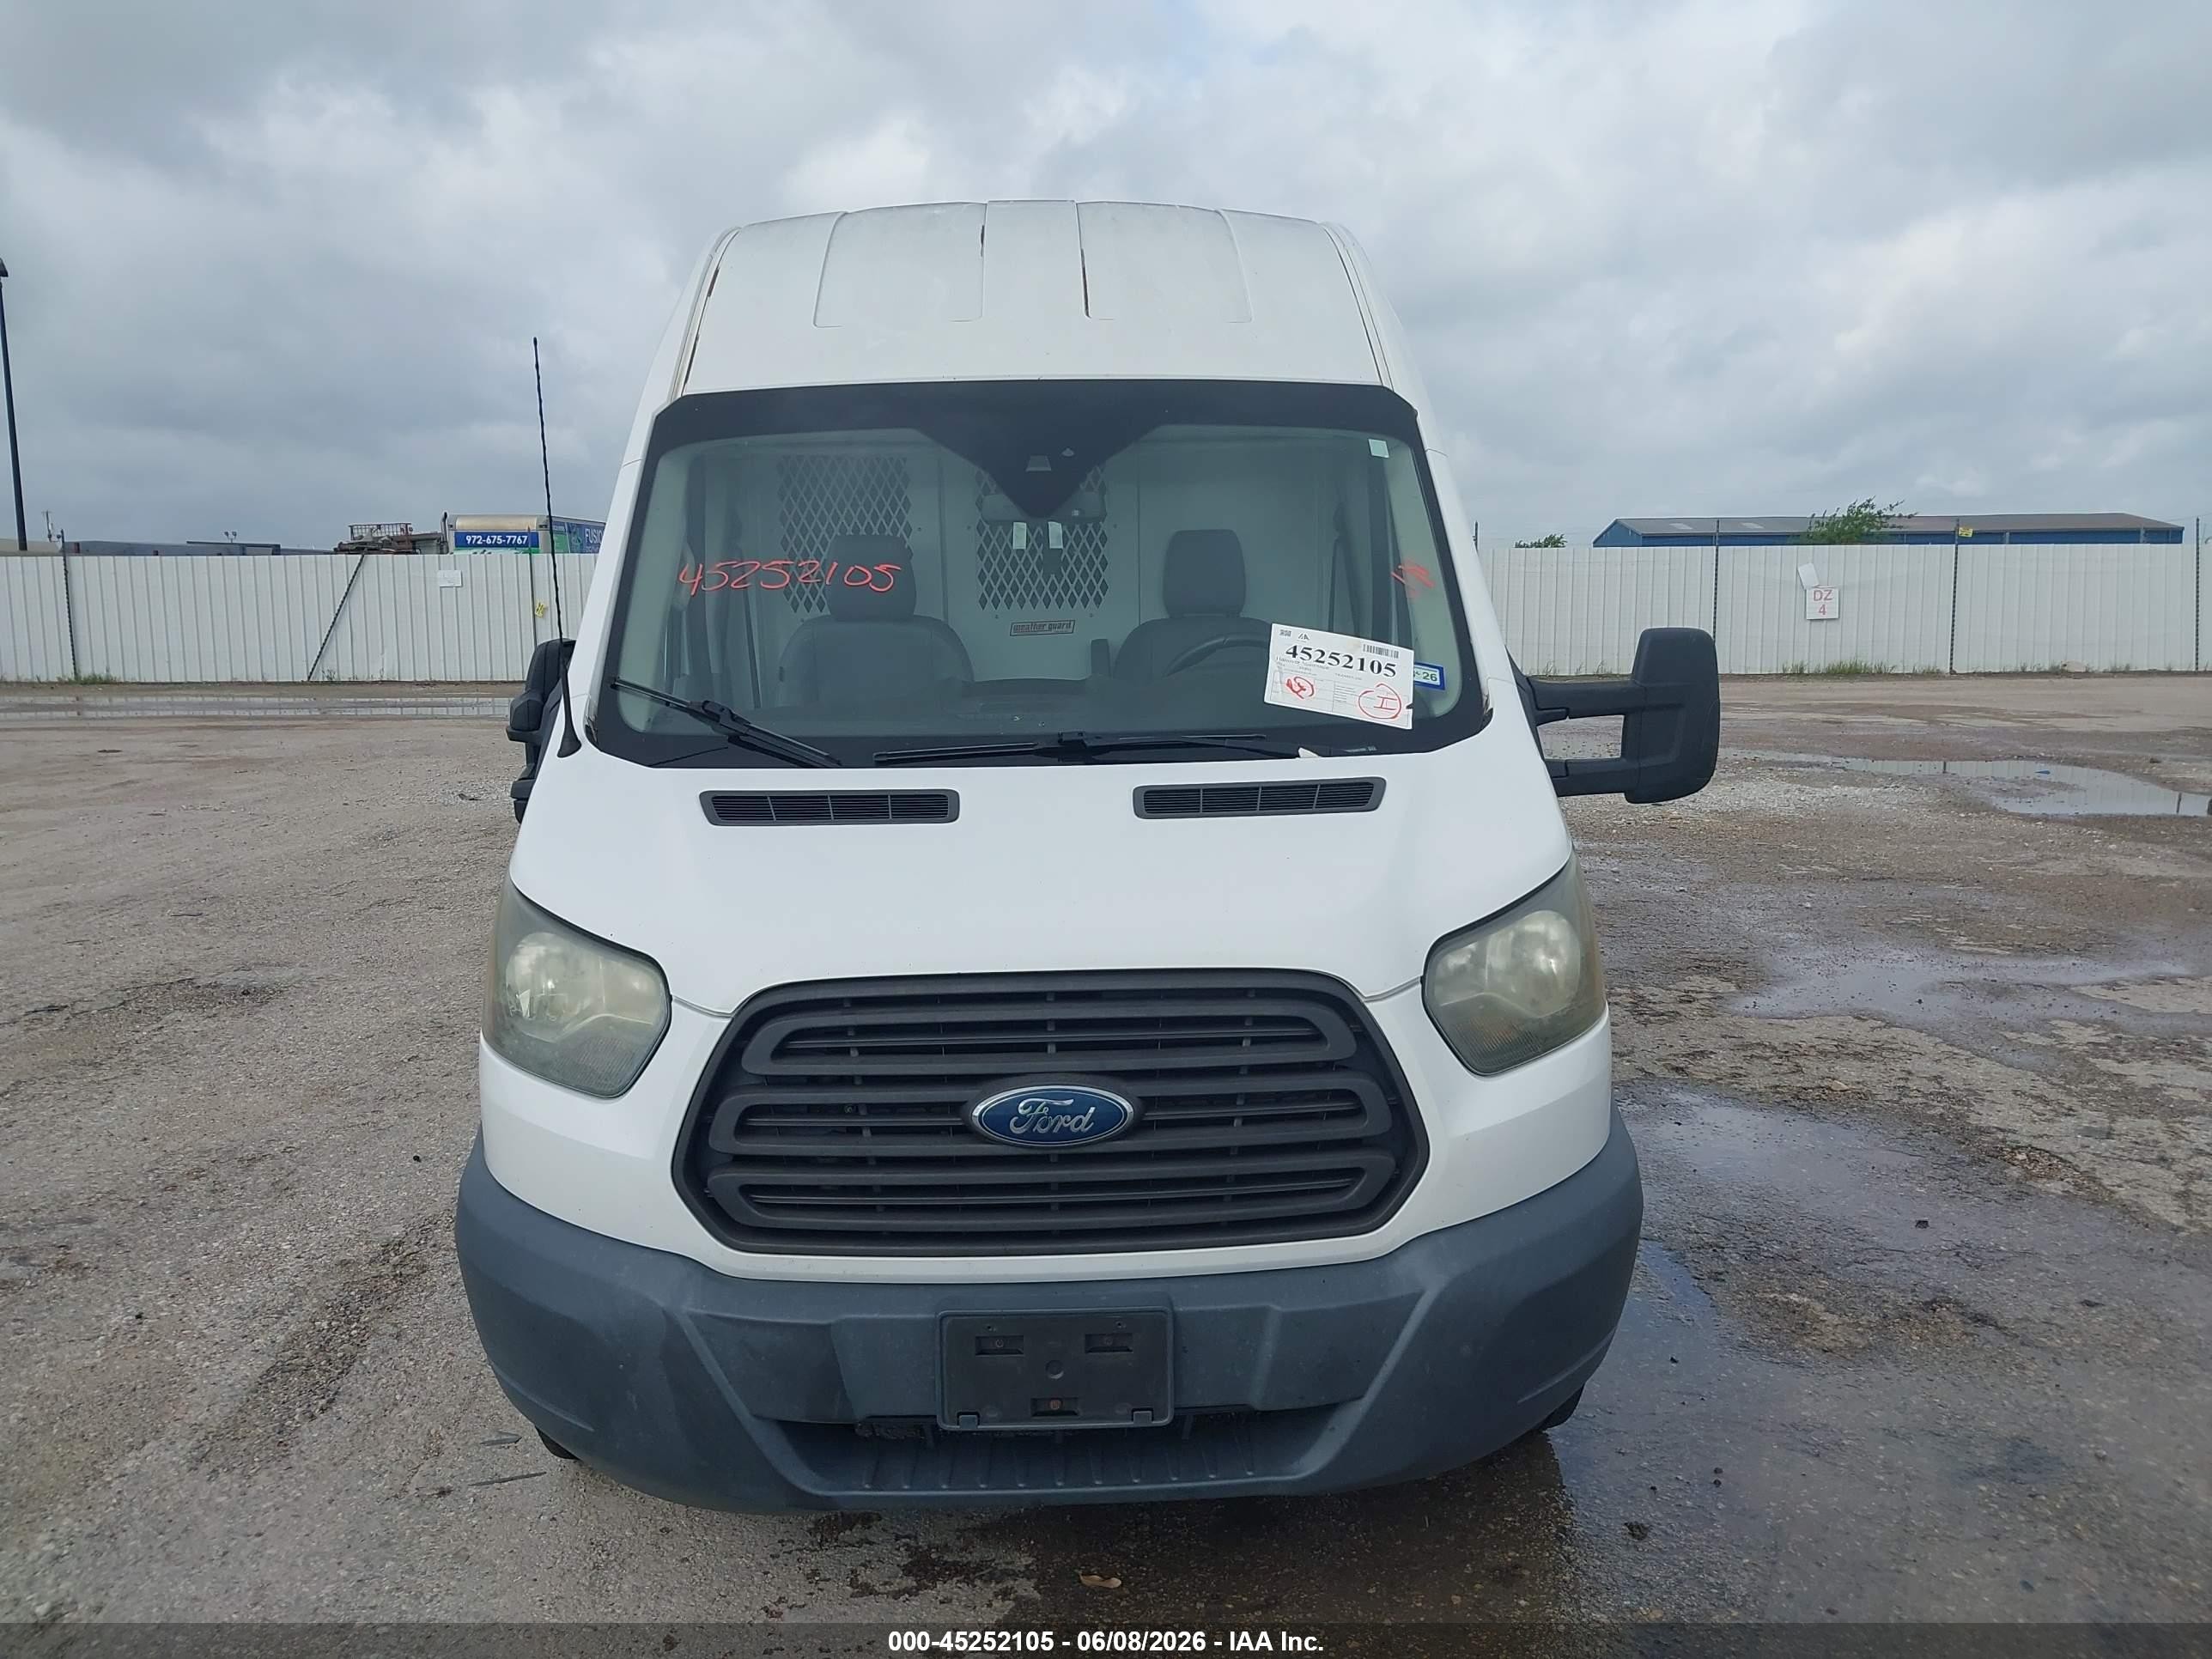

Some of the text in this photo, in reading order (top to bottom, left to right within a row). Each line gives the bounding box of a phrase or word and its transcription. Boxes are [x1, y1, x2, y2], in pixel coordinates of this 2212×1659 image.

[465, 535, 528, 544] 972-675-7767
[678, 559, 902, 596] 45252105
[1813, 589, 1833, 601] DZ
[1818, 604, 1826, 616] 4
[1285, 644, 1397, 678] 45252105
[1009, 1097, 1096, 1134] Ford
